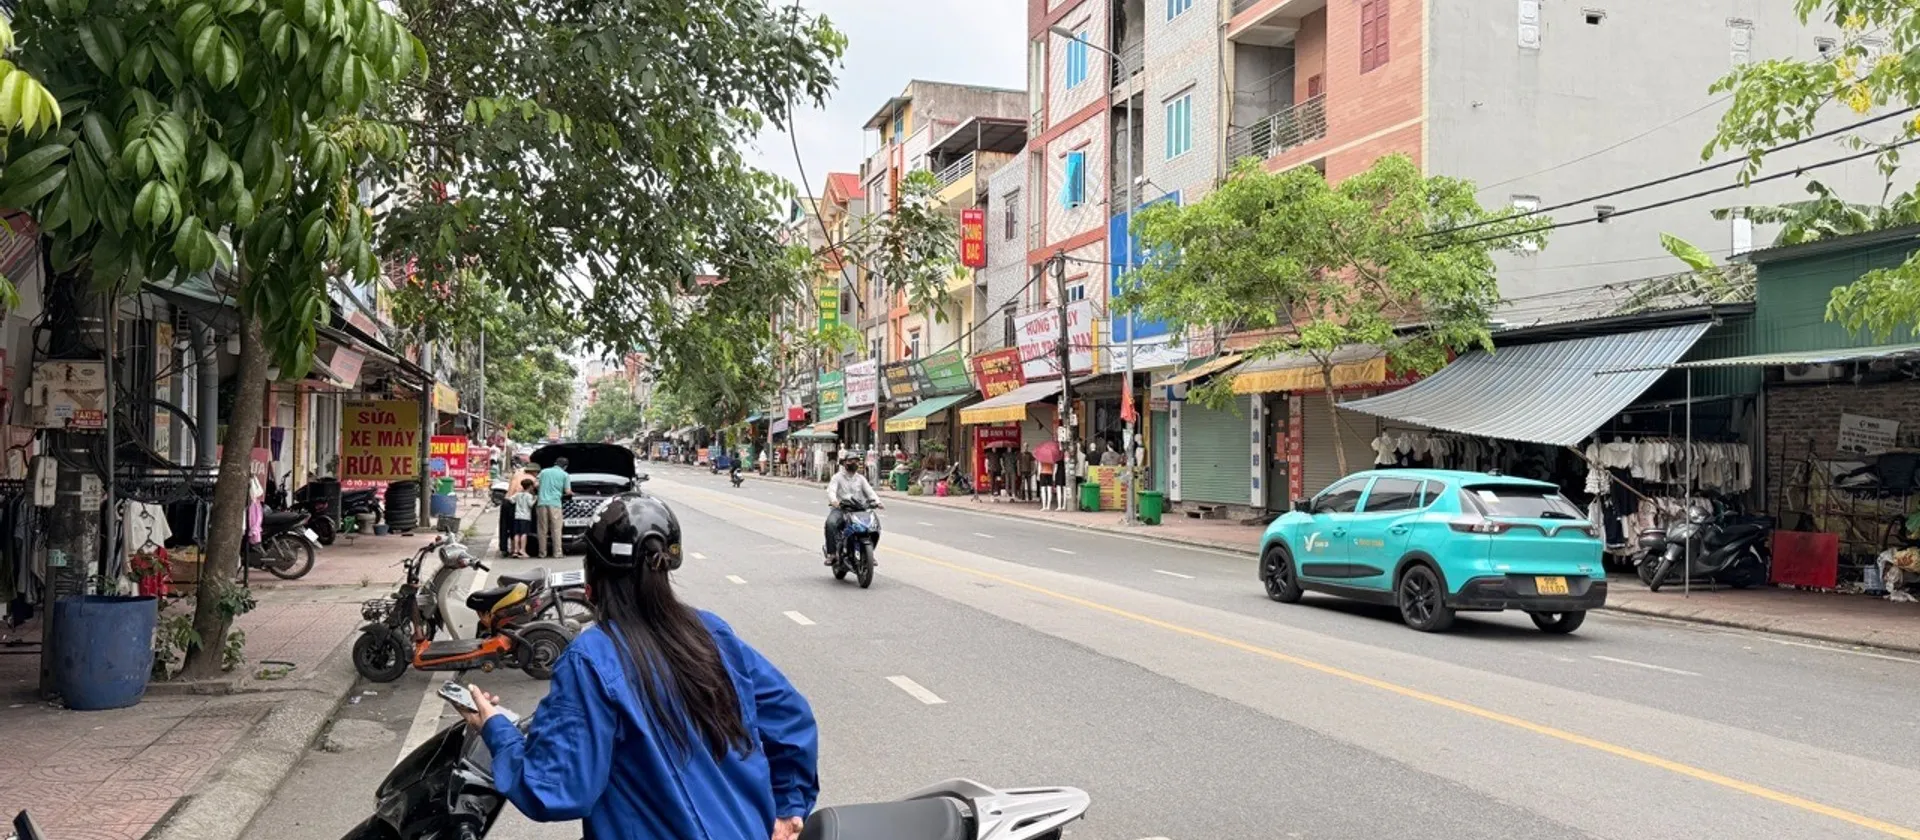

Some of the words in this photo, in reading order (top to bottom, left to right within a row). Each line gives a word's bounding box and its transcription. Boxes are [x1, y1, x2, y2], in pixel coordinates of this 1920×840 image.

[358, 408, 396, 425] SỬA
[350, 430, 371, 447] XE
[377, 428, 415, 447] MÁY
[346, 449, 383, 475] RỬA
[390, 456, 413, 475] XE
